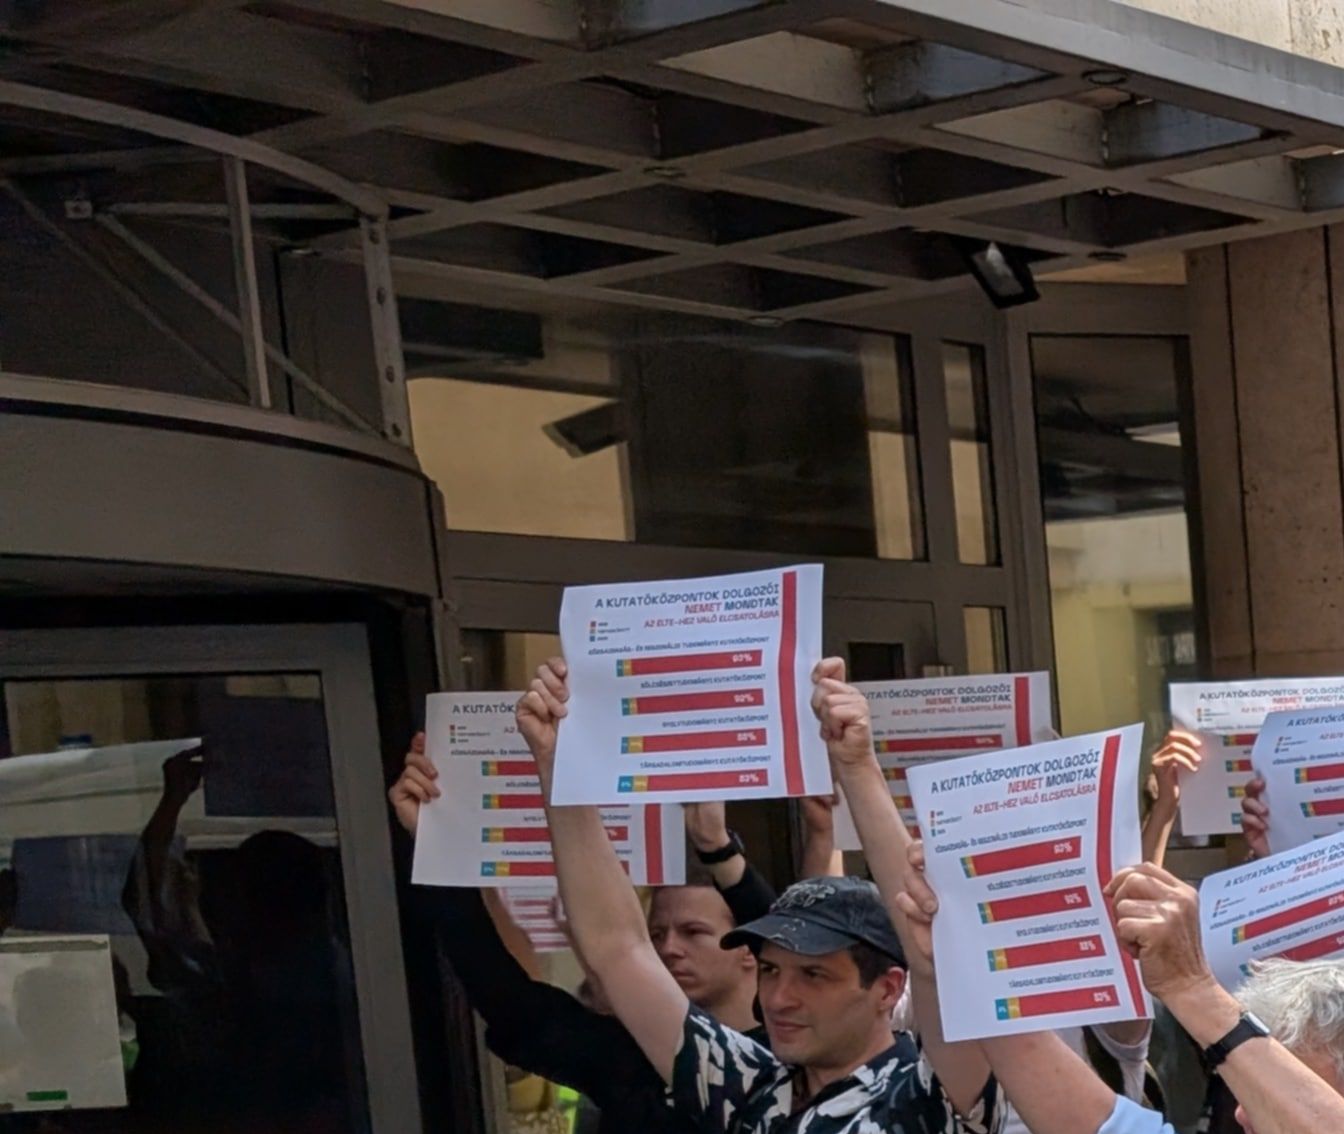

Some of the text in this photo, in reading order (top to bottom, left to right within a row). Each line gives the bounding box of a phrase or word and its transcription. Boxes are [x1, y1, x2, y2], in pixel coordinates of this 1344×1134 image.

[595, 584, 779, 609] A KUTATÓKÖZPONTOK DOLGOZÓI
[685, 597, 778, 614] NEMET MONDTAK
[697, 614, 717, 625] VALÓ
[734, 694, 753, 703] 92%
[863, 687, 955, 700] UTATÓKÖZPONTOK
[961, 694, 1010, 703] MONDTAK
[931, 750, 1100, 793] A KUTATÓKÖZPONTOK DOLGOZÓI
[1008, 767, 1097, 793] NEMET MONDTAK
